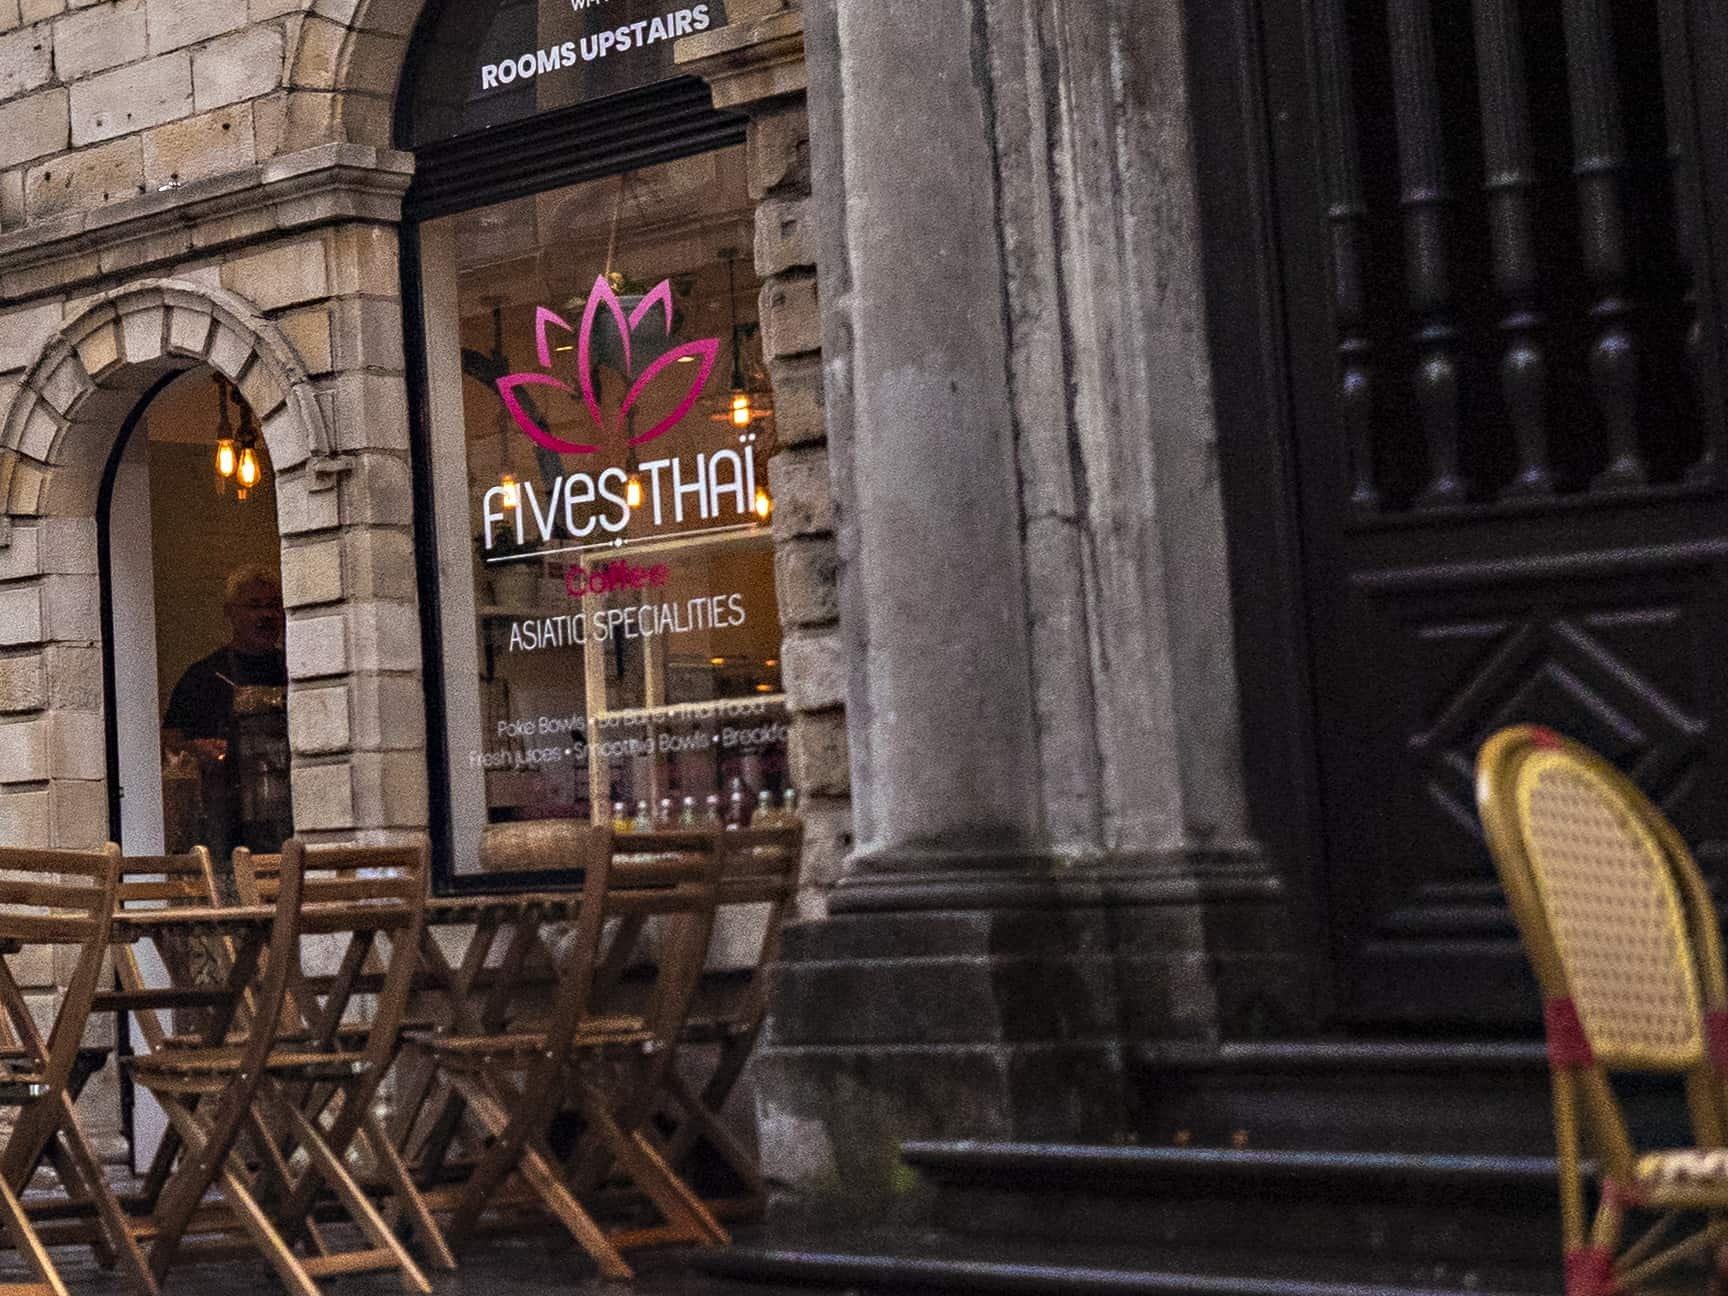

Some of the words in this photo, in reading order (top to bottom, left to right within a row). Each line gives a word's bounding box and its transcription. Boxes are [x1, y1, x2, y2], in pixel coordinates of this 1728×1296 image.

[481, 42, 575, 89] ROOMS
[580, 4, 710, 61] UPSTAIRS
[639, 433, 757, 527] THAÏ
[565, 559, 671, 598] Coffee
[509, 612, 587, 652] ASIATIC
[593, 593, 746, 642] SPECIALITIES
[497, 718, 536, 737] Poke
[538, 713, 586, 735] Bowls
